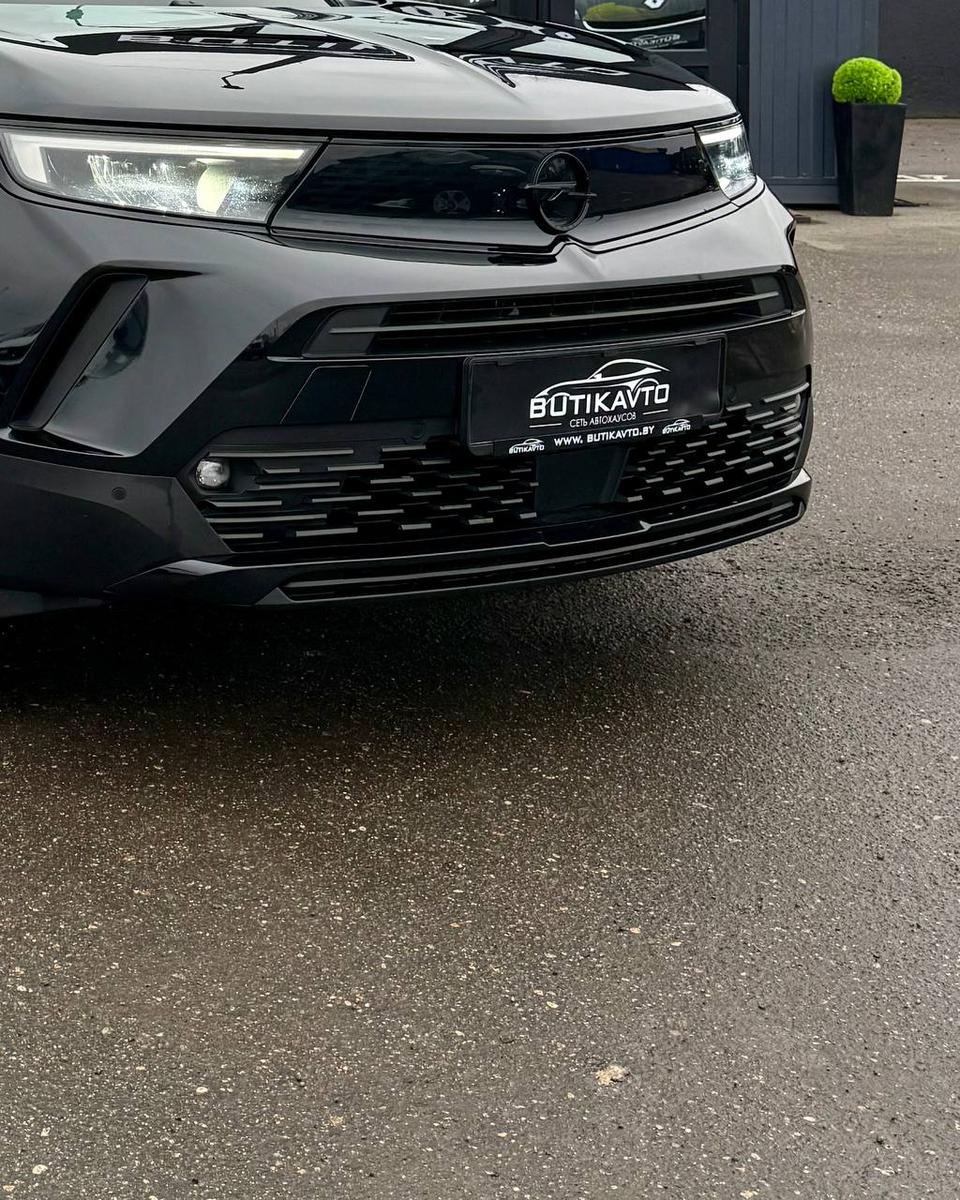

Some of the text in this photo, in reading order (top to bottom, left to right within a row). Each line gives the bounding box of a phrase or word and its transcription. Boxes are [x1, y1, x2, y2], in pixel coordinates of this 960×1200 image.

[529, 383, 670, 419] BUTIKAVTO
[569, 412, 637, 428] СЕТЬ АВТОХАУСОВ
[553, 425, 656, 447] WWW. BUTIKAVTO.BY
[508, 443, 545, 454] BUTIKAVTO
